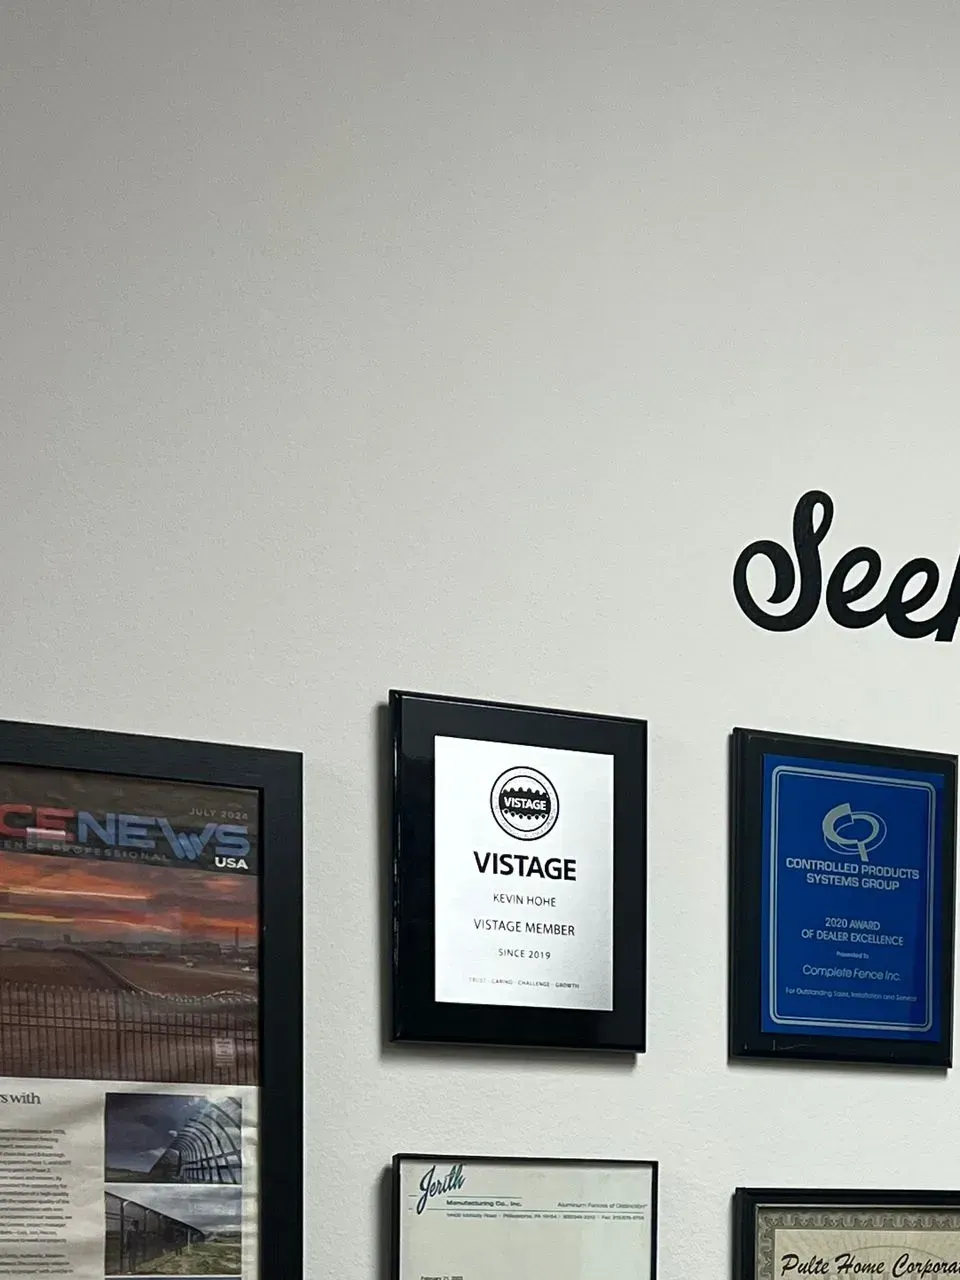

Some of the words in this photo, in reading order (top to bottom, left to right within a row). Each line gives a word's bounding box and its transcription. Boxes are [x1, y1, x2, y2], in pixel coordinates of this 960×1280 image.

[503, 796, 547, 811] VISTAGE
[189, 807, 216, 817] JULY
[221, 810, 248, 820] 2024
[214, 857, 248, 870] USA
[473, 851, 576, 881] VISTAGE
[786, 857, 859, 874] CONTROLLED
[861, 865, 920, 880] PRODUCTS
[806, 872, 859, 887] SYSTEMS
[861, 878, 900, 890] GROUP
[493, 893, 523, 905] KEVIN
[527, 896, 556, 907] HOHE
[473, 918, 521, 932] VISTAGE
[525, 923, 575, 936] MEMBER
[825, 917, 848, 928] 2020
[849, 919, 880, 930] AWARD
[801, 928, 814, 939] OF
[816, 930, 848, 942] DEALER
[851, 933, 904, 946] EXCELLENCE
[498, 948, 525, 958] SINCE
[529, 950, 551, 960] 2019
[802, 964, 852, 978] Complete
[854, 968, 884, 980] Fence
[884, 970, 901, 981] Inc.
[796, 987, 832, 998] Outstanding
[9, 1092, 41, 1104] with
[416, 1163, 466, 1215] Jerith
[781, 1253, 829, 1277] Pulte
[835, 1253, 885, 1274] Home
